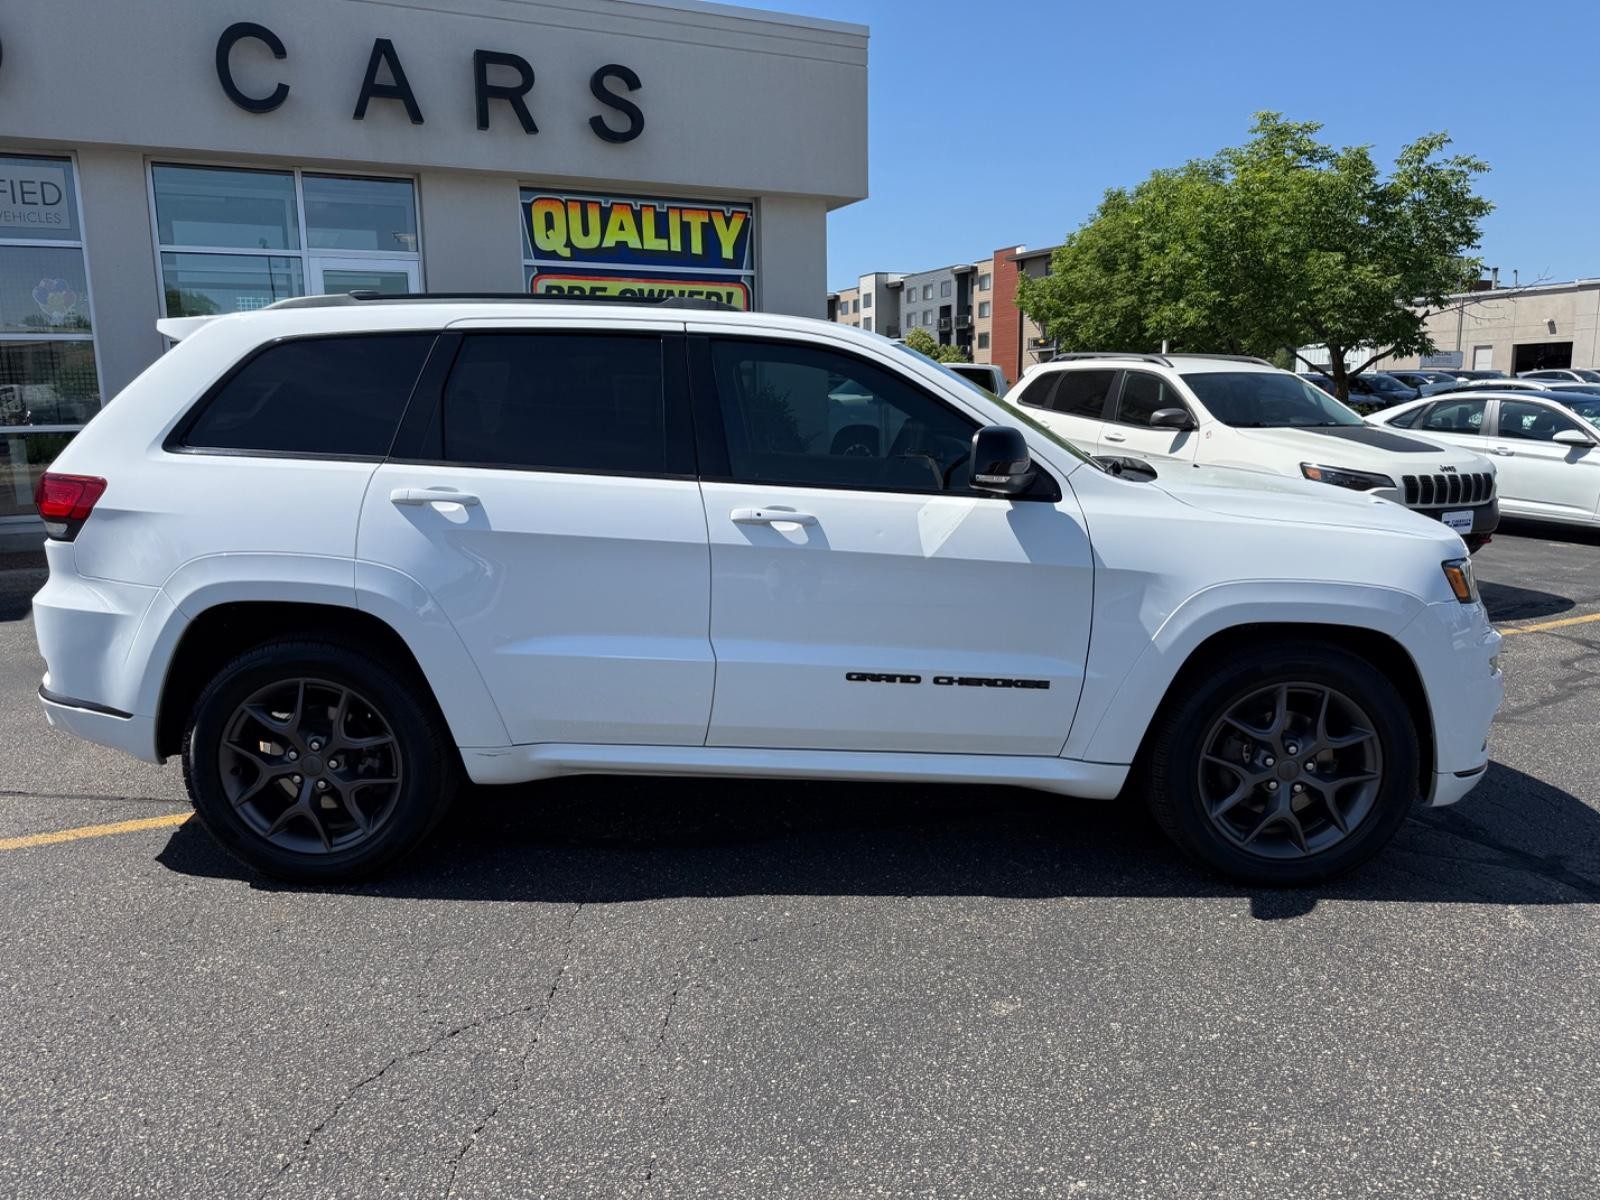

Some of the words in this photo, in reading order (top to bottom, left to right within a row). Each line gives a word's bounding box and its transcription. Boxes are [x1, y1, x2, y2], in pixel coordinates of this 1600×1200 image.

[215, 22, 645, 144] CARS
[531, 197, 746, 259] QUALITY
[846, 672, 921, 684] GRAND
[933, 676, 1050, 689] CHEROKEE
